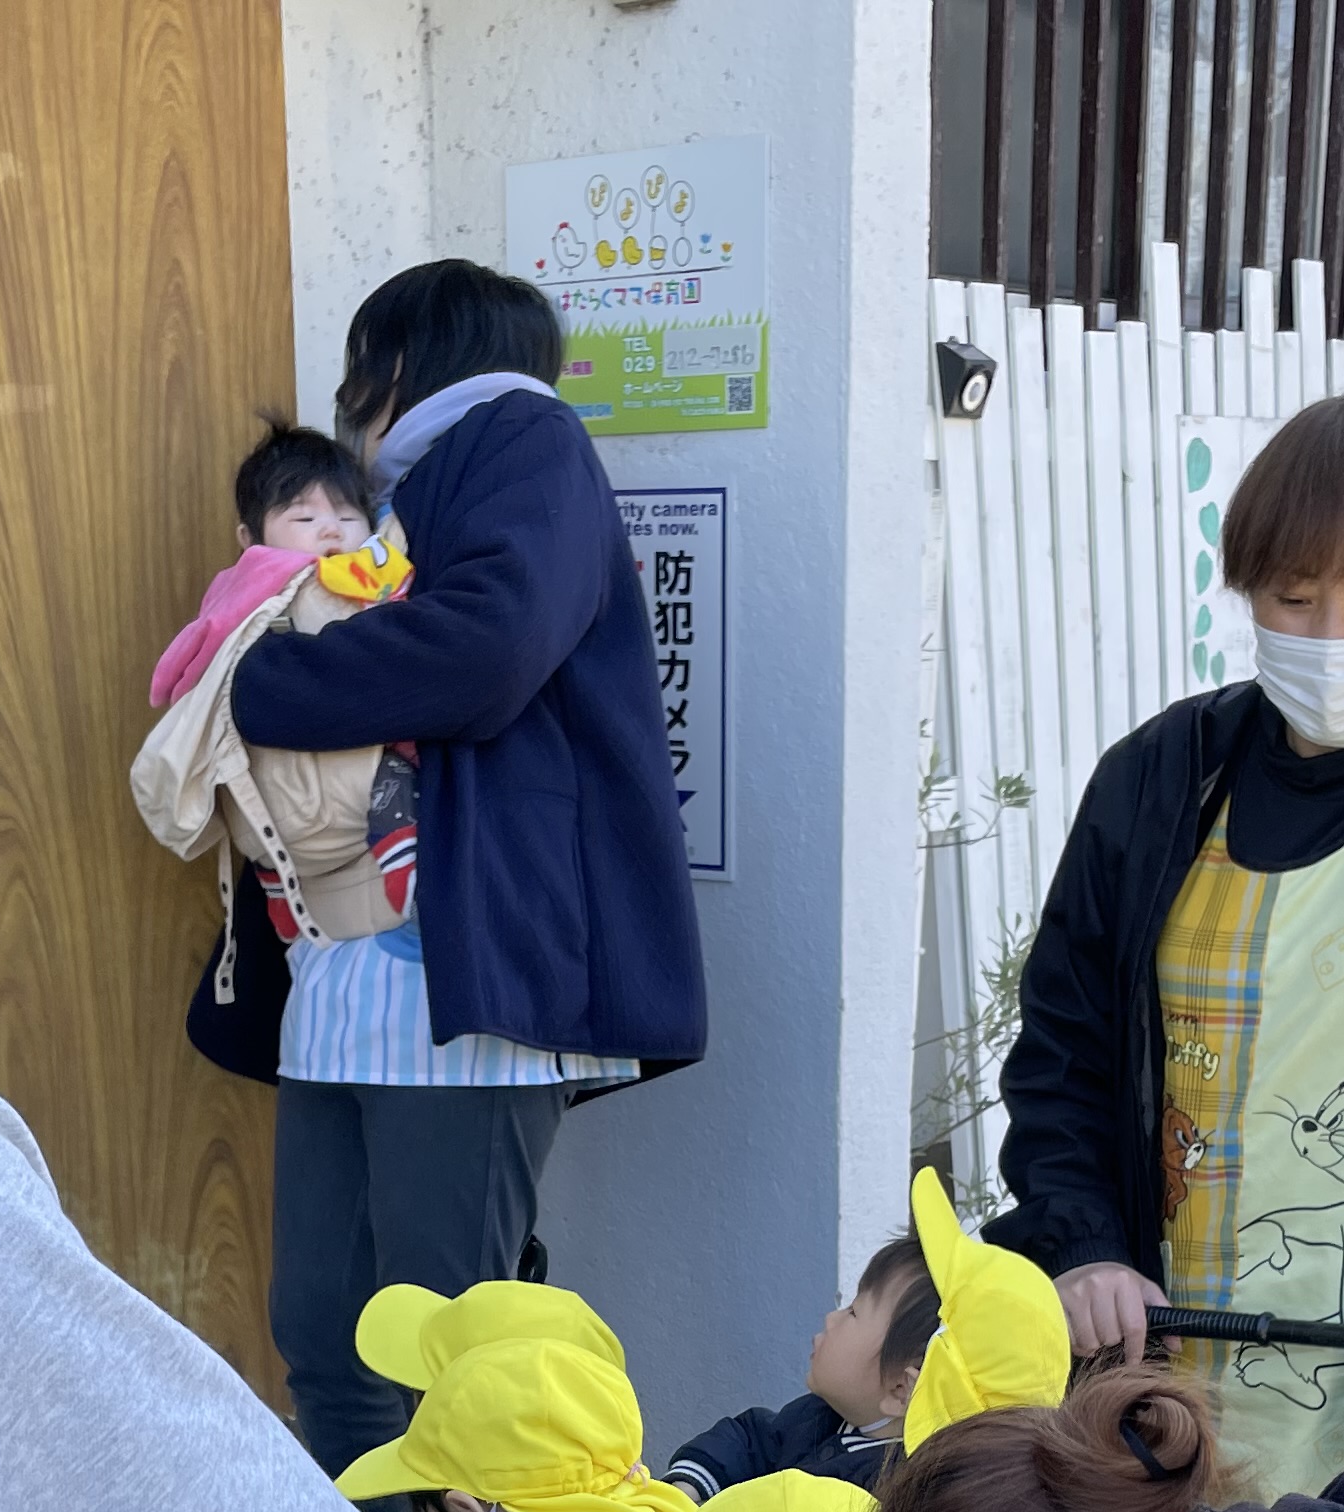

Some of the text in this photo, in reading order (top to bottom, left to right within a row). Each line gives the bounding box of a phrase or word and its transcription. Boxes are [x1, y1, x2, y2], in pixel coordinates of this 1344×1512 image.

[558, 277, 701, 311] はたらくママ保育園
[623, 336, 652, 353] TEL
[623, 380, 684, 395] ホームページ
[651, 503, 718, 517] camera
[658, 522, 699, 536] now.
[653, 550, 695, 778] 防犯カメラ
